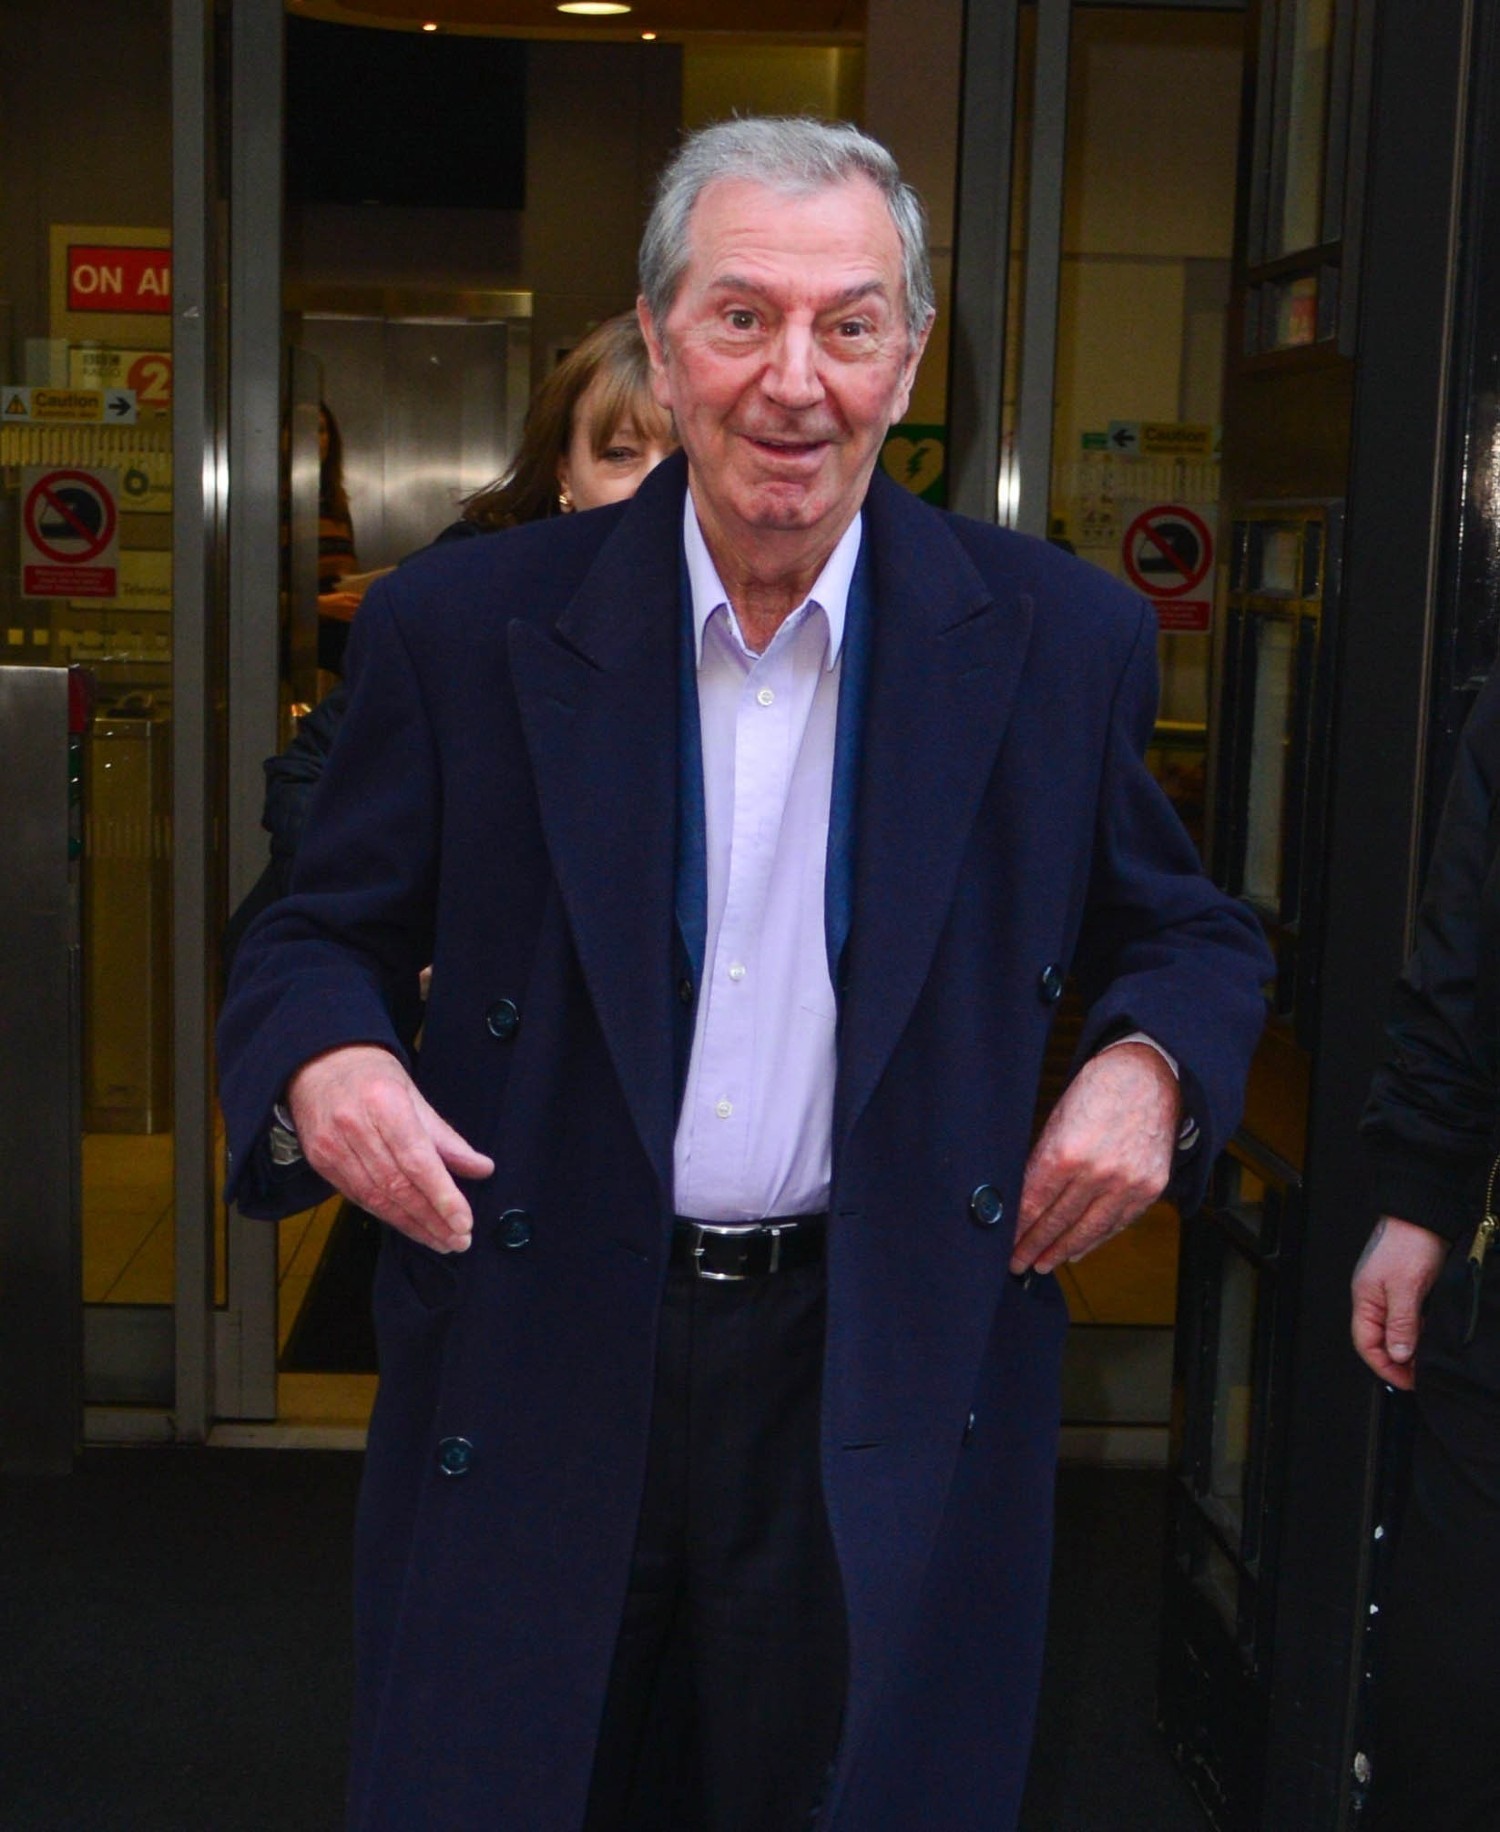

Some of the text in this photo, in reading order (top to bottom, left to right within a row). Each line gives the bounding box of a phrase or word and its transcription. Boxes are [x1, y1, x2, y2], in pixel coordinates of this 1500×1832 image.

[73, 265, 170, 296] ON AI
[140, 361, 170, 400] 2
[35, 392, 99, 409] Caution
